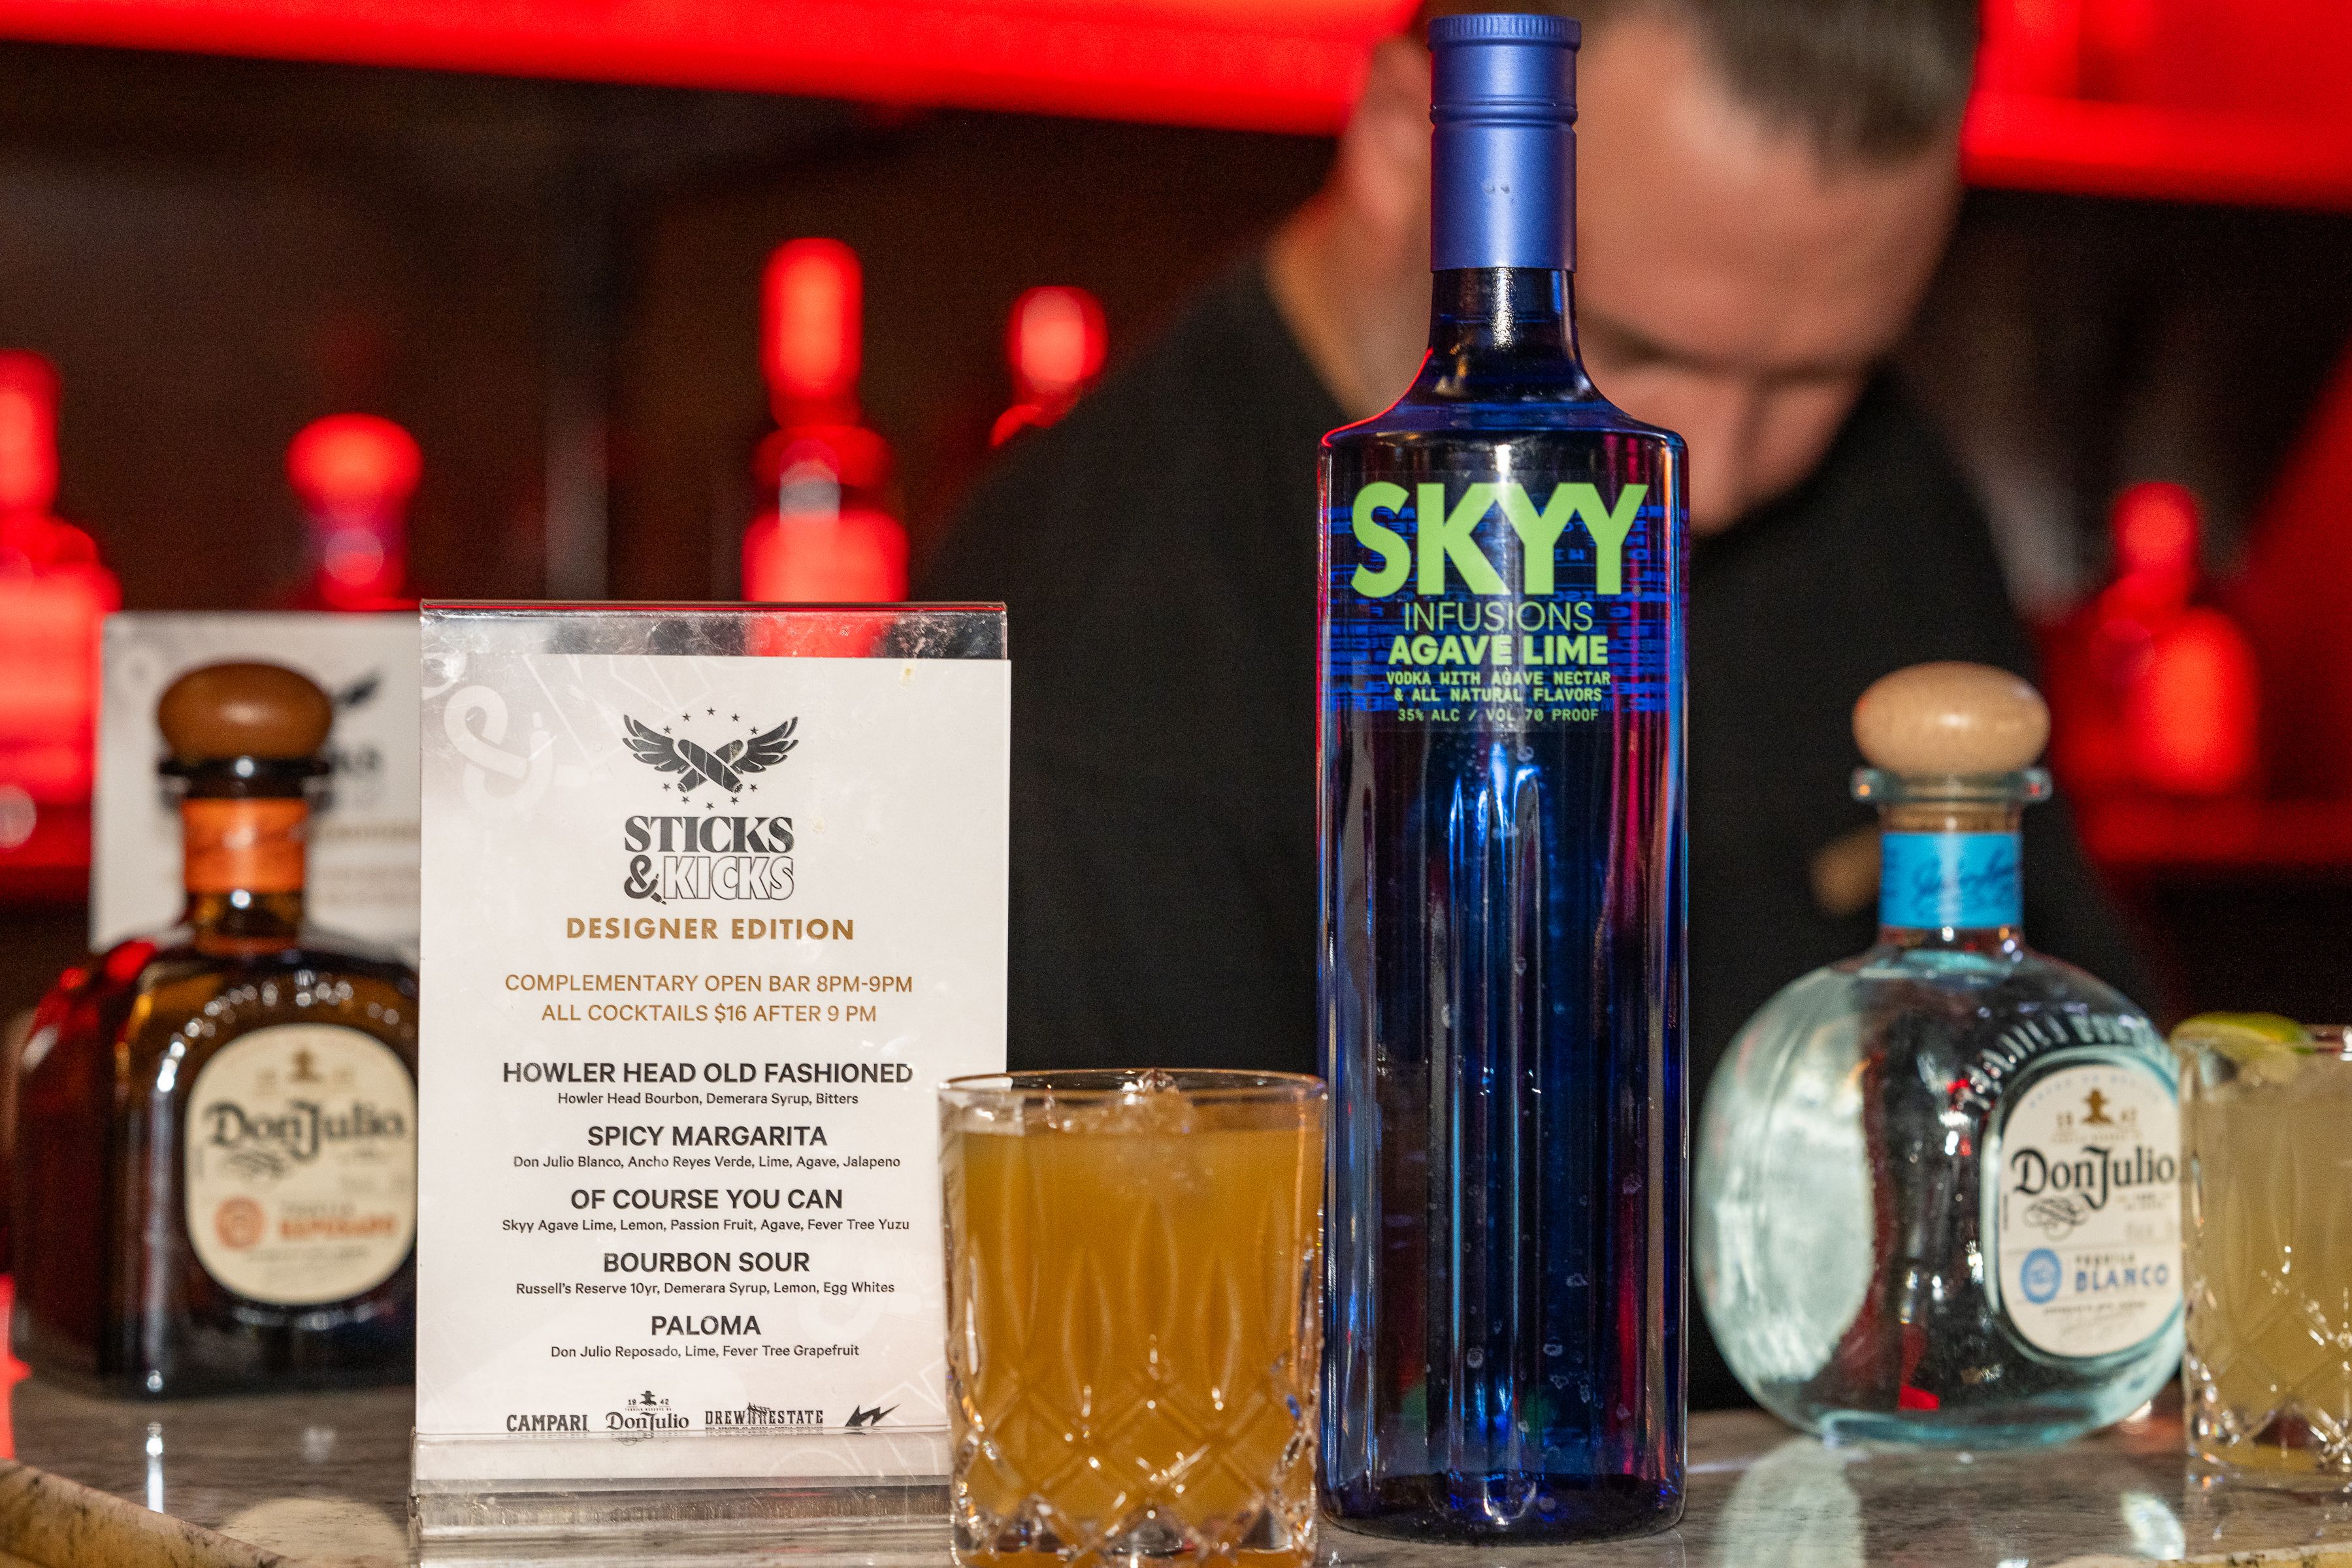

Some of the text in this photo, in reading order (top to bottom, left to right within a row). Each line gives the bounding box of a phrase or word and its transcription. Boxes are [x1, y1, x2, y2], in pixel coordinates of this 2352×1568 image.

[1350, 481, 1650, 598] SKYY
[1404, 601, 1593, 631] INFUSIONS
[1388, 635, 1609, 666] AGAVE LIME
[1386, 671, 1611, 686] VODKA WITH AGAVE NECTAR
[1394, 688, 1603, 702] & ALL NATURAL FLAVORS
[1397, 708, 1599, 723] 35% ALC / VOL 70 PROOF
[625, 815, 796, 855] STICKS
[567, 917, 855, 941] DESIGNER EDITION
[506, 974, 913, 994] COMPLEMENTARY OPEN BAR 8PM-9PM
[542, 1004, 877, 1024] ALL COCKTAILS $16 AFTER 9 PM
[504, 1063, 914, 1084] HOWLER HEAD OLD FASHIONED
[559, 1092, 860, 1107] Howler Head Bourbon, Demerara Syrup, Bitters
[588, 1126, 828, 1147] SPICY MARGARITA
[514, 1156, 902, 1171] Don Julio Blanco, Ancho Reyes Verde, Lime, Agave, Jalapeno
[571, 1189, 843, 1211] OF COURSE YOU CAN
[502, 1219, 910, 1234] Skyy Agave Lime, Lemon, Passion Fruit, Agave, Fever Tree Yuzu
[604, 1252, 811, 1274] BOURBON SOUR
[517, 1282, 896, 1297] Russell's Reserve 10yr, Demerara Syrup, Lemon, Egg Whites
[652, 1316, 762, 1337] PALOMA
[551, 1345, 860, 1360] Don Julio Reposado, Lime, Fever Tree Grapefruit
[506, 1414, 588, 1432] CAMPARI
[705, 1409, 824, 1425] DREW ESTATE
